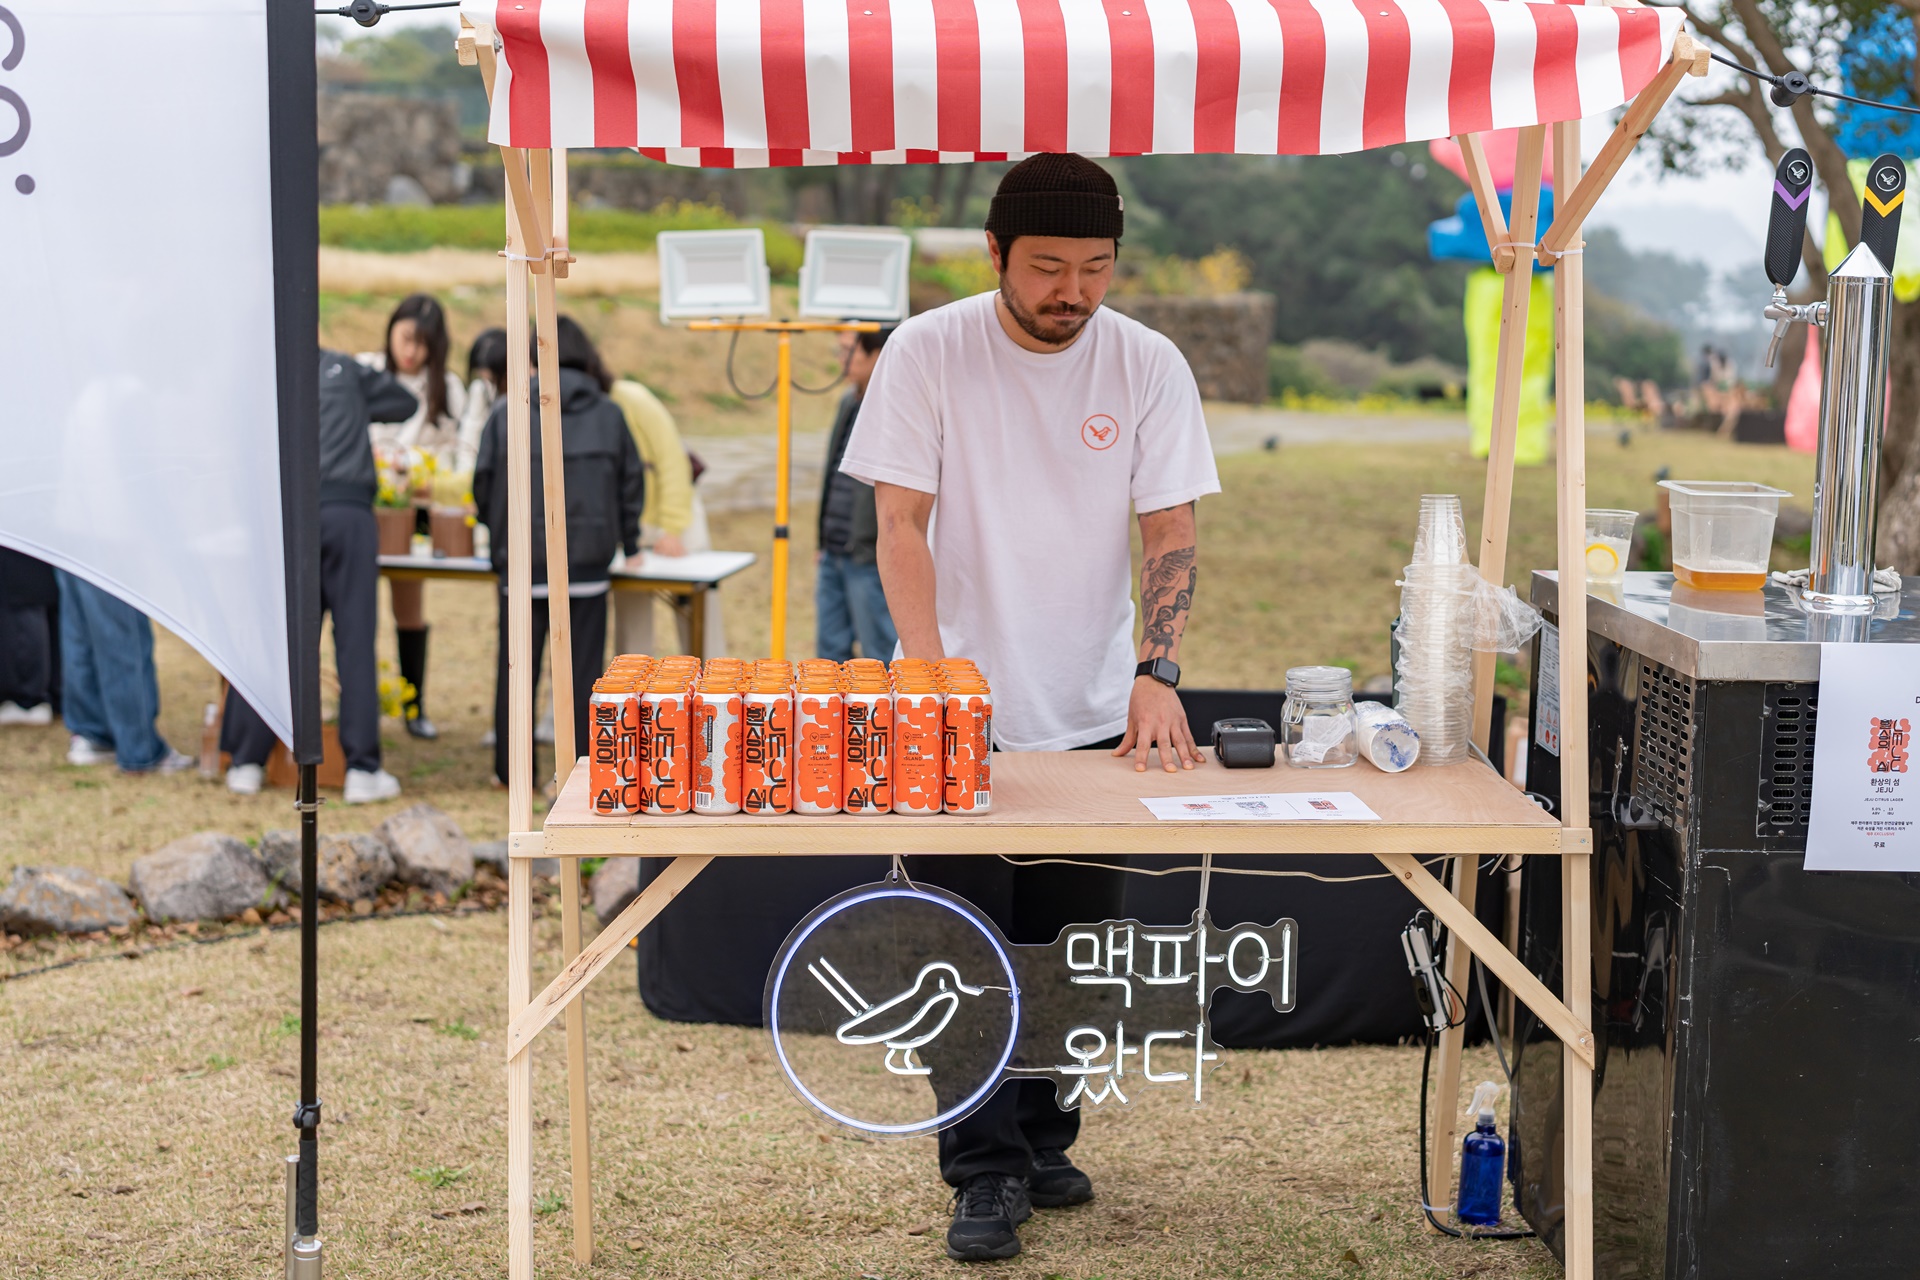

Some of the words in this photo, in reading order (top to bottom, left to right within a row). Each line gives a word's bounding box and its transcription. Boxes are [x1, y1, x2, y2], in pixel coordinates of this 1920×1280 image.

[621, 707, 637, 808] JEJU
[655, 707, 675, 808] JEJU
[769, 707, 786, 808] JEJU
[871, 706, 888, 807] JEJU
[1870, 778, 1891, 786] 환상의
[1893, 778, 1900, 786] 섬
[1890, 719, 1903, 772] JEJU
[1066, 923, 1291, 1009] 맥파이
[1055, 1020, 1218, 1106] 왔다
